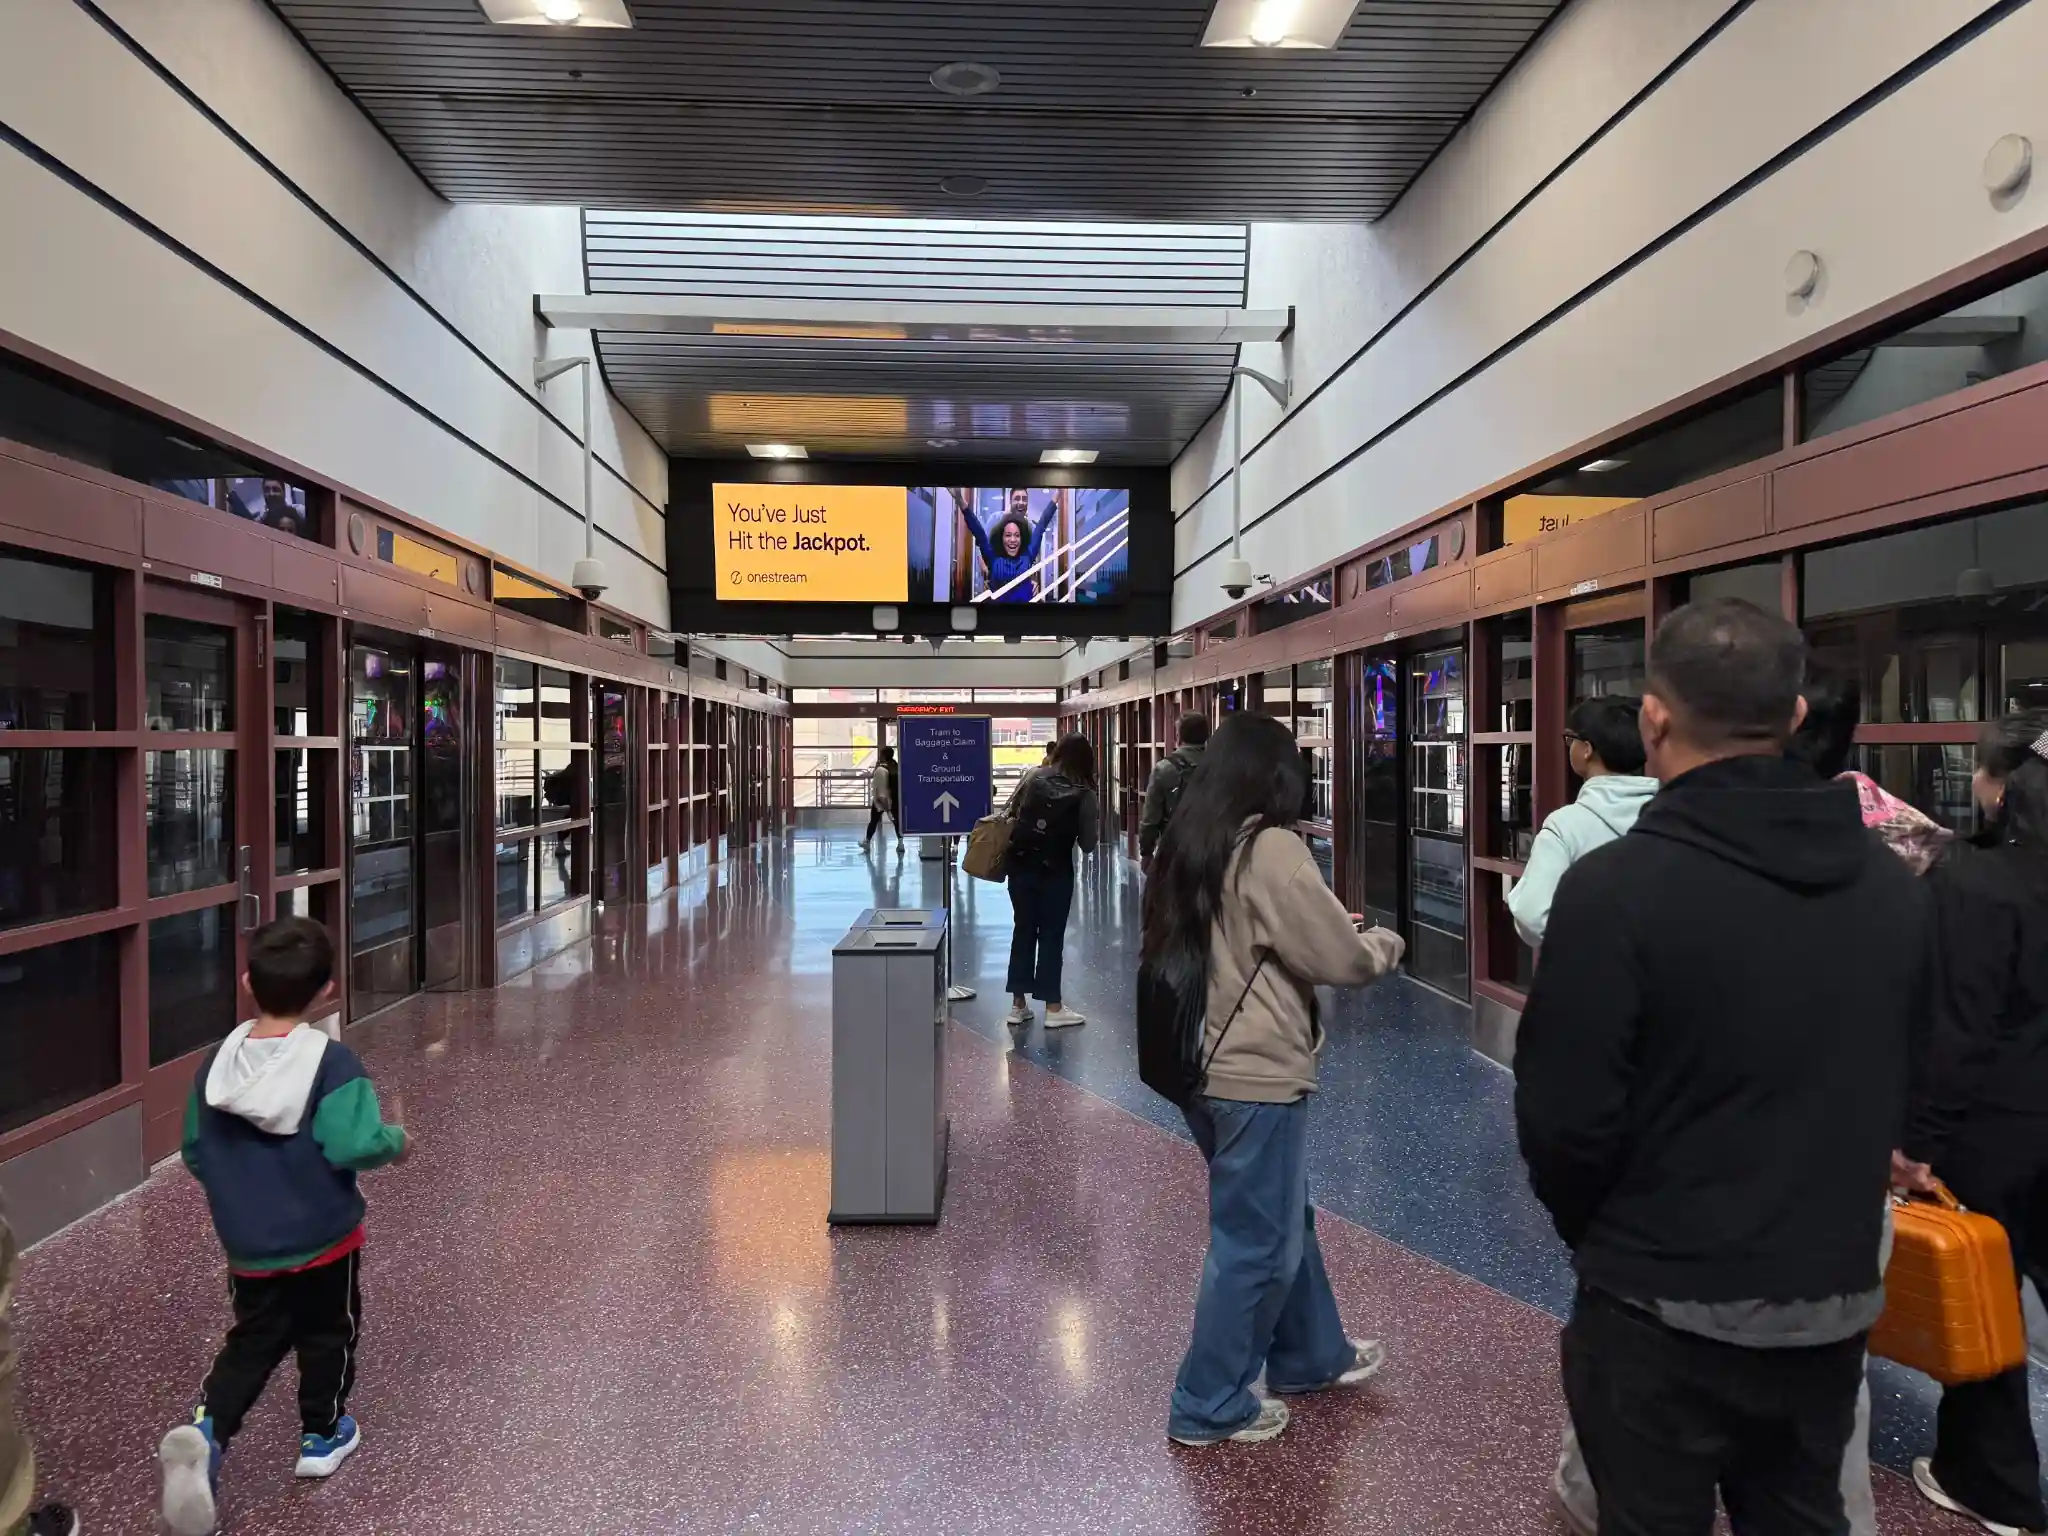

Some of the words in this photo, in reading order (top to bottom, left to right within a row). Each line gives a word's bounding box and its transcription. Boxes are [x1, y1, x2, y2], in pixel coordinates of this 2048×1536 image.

[728, 503, 787, 523] You've
[792, 505, 827, 524] Just
[729, 531, 754, 550] Hit
[757, 532, 788, 550] the
[793, 532, 870, 555] Jackpot.
[747, 573, 807, 584] onestream
[929, 728, 951, 736] Tram
[952, 728, 961, 736] to
[915, 738, 951, 748] Baggage
[953, 738, 976, 746] Claim
[942, 752, 949, 760] &
[931, 764, 961, 773] Ground
[917, 774, 975, 783] Transportation
